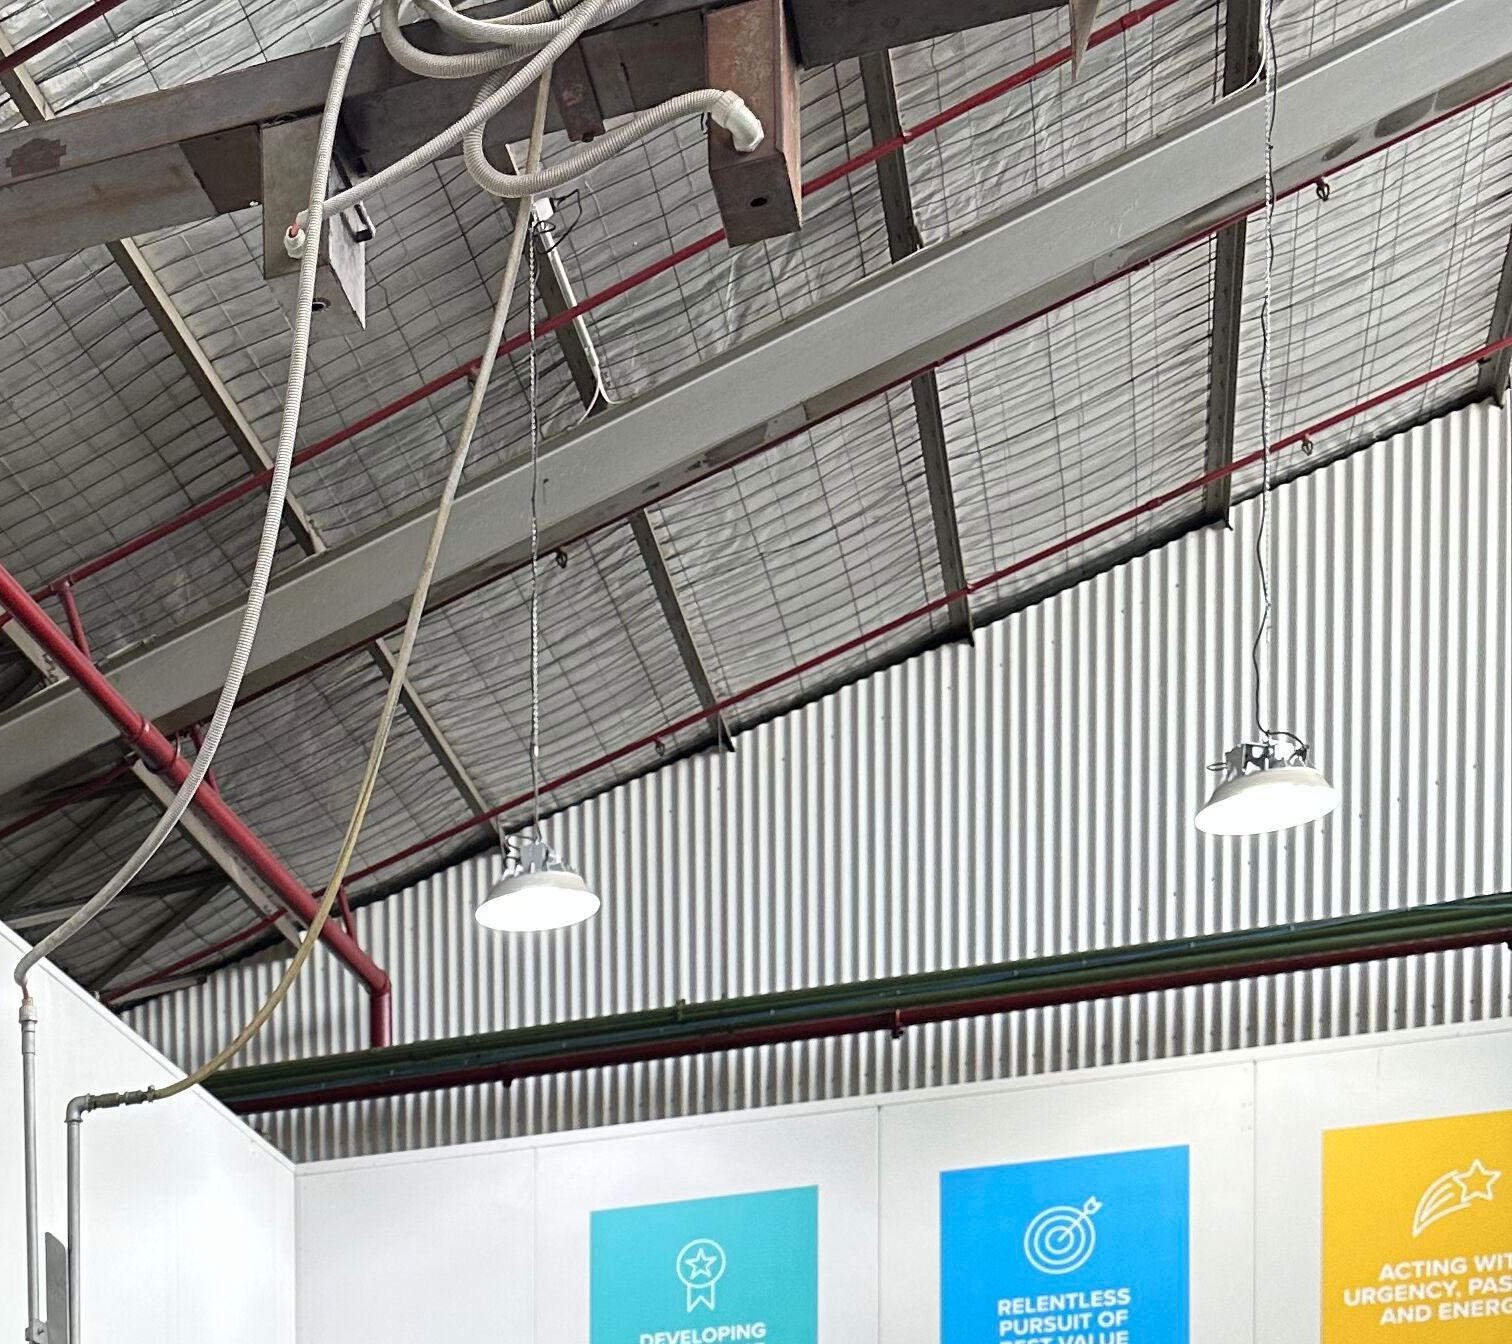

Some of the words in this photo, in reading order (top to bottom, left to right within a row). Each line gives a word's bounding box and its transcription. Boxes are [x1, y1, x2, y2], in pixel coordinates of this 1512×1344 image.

[1378, 1256, 1468, 1282] ACTING
[997, 1287, 1131, 1316] RELENTLESS
[1343, 1280, 1461, 1306] URGENCY,
[999, 1312, 1092, 1337] PURSUIT
[1097, 1309, 1129, 1328] OF
[1379, 1305, 1432, 1325] AND
